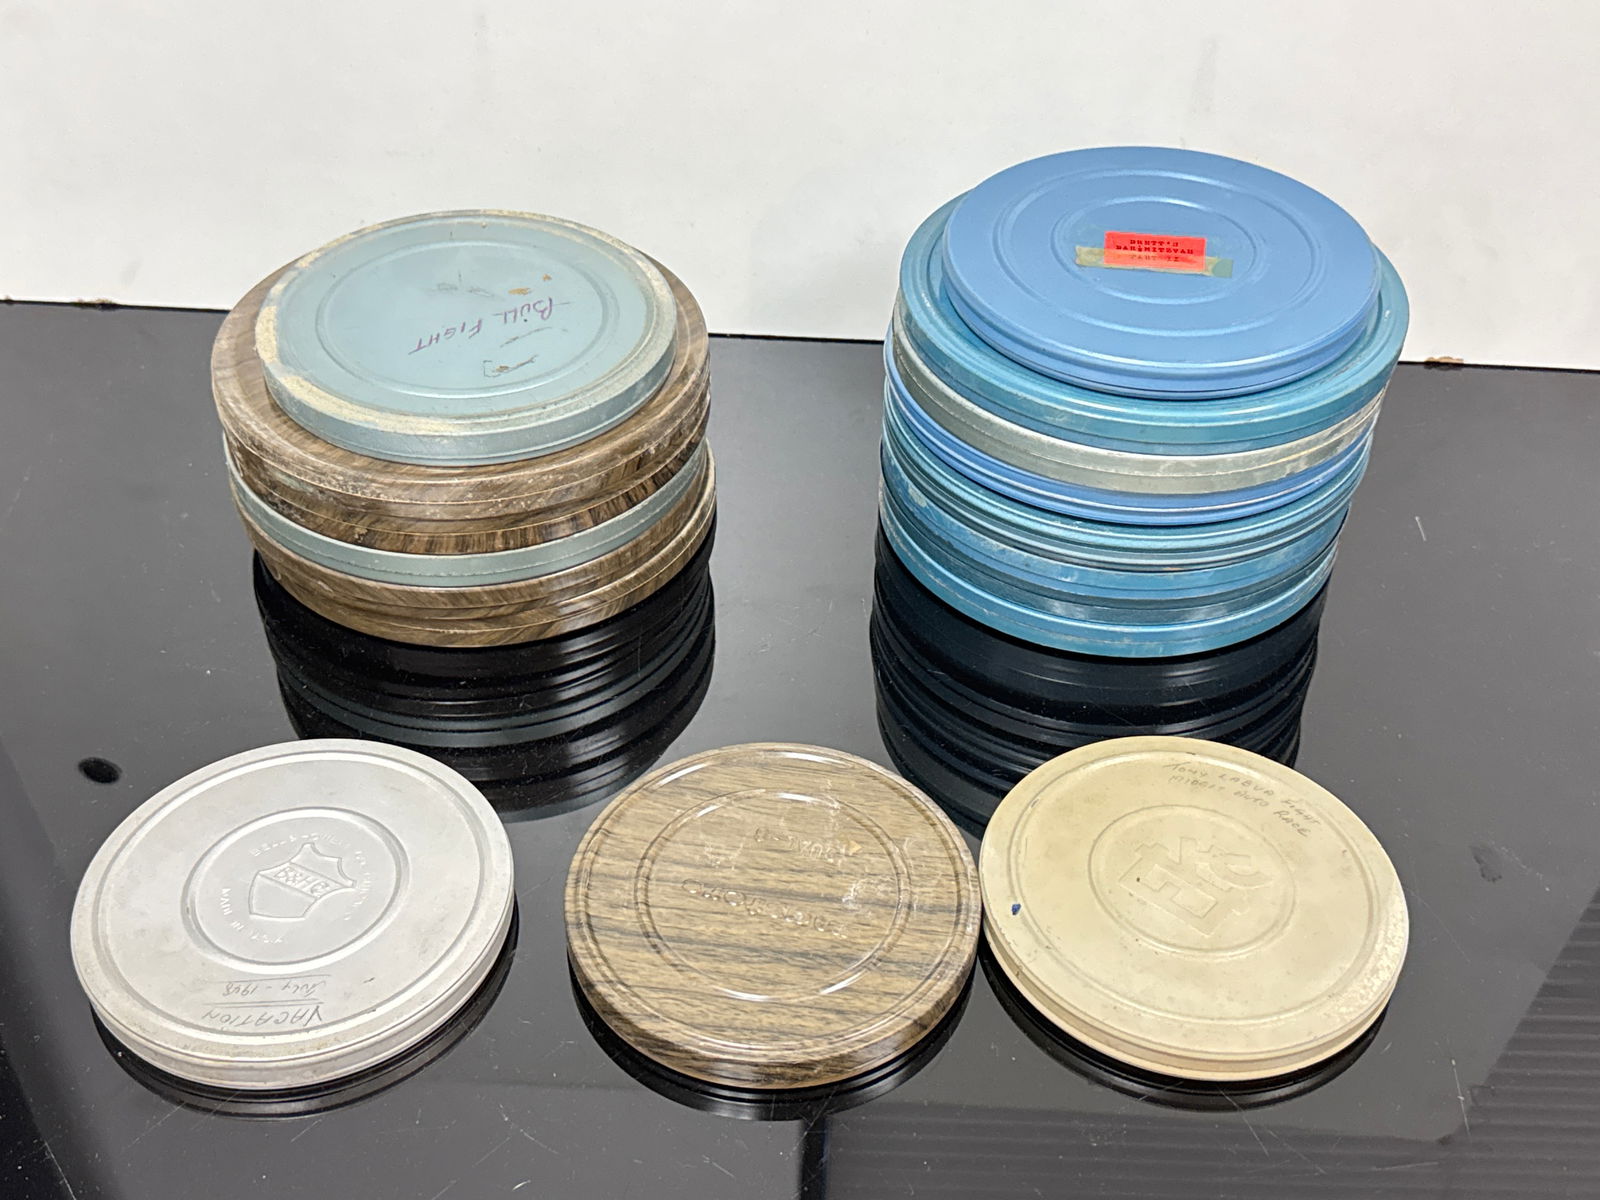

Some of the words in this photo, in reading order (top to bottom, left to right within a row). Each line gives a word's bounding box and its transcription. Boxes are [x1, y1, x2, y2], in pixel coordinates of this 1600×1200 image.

[408, 318, 483, 355] FIGHT
[222, 981, 259, 997] 1948
[201, 1004, 322, 1028] VACATION
